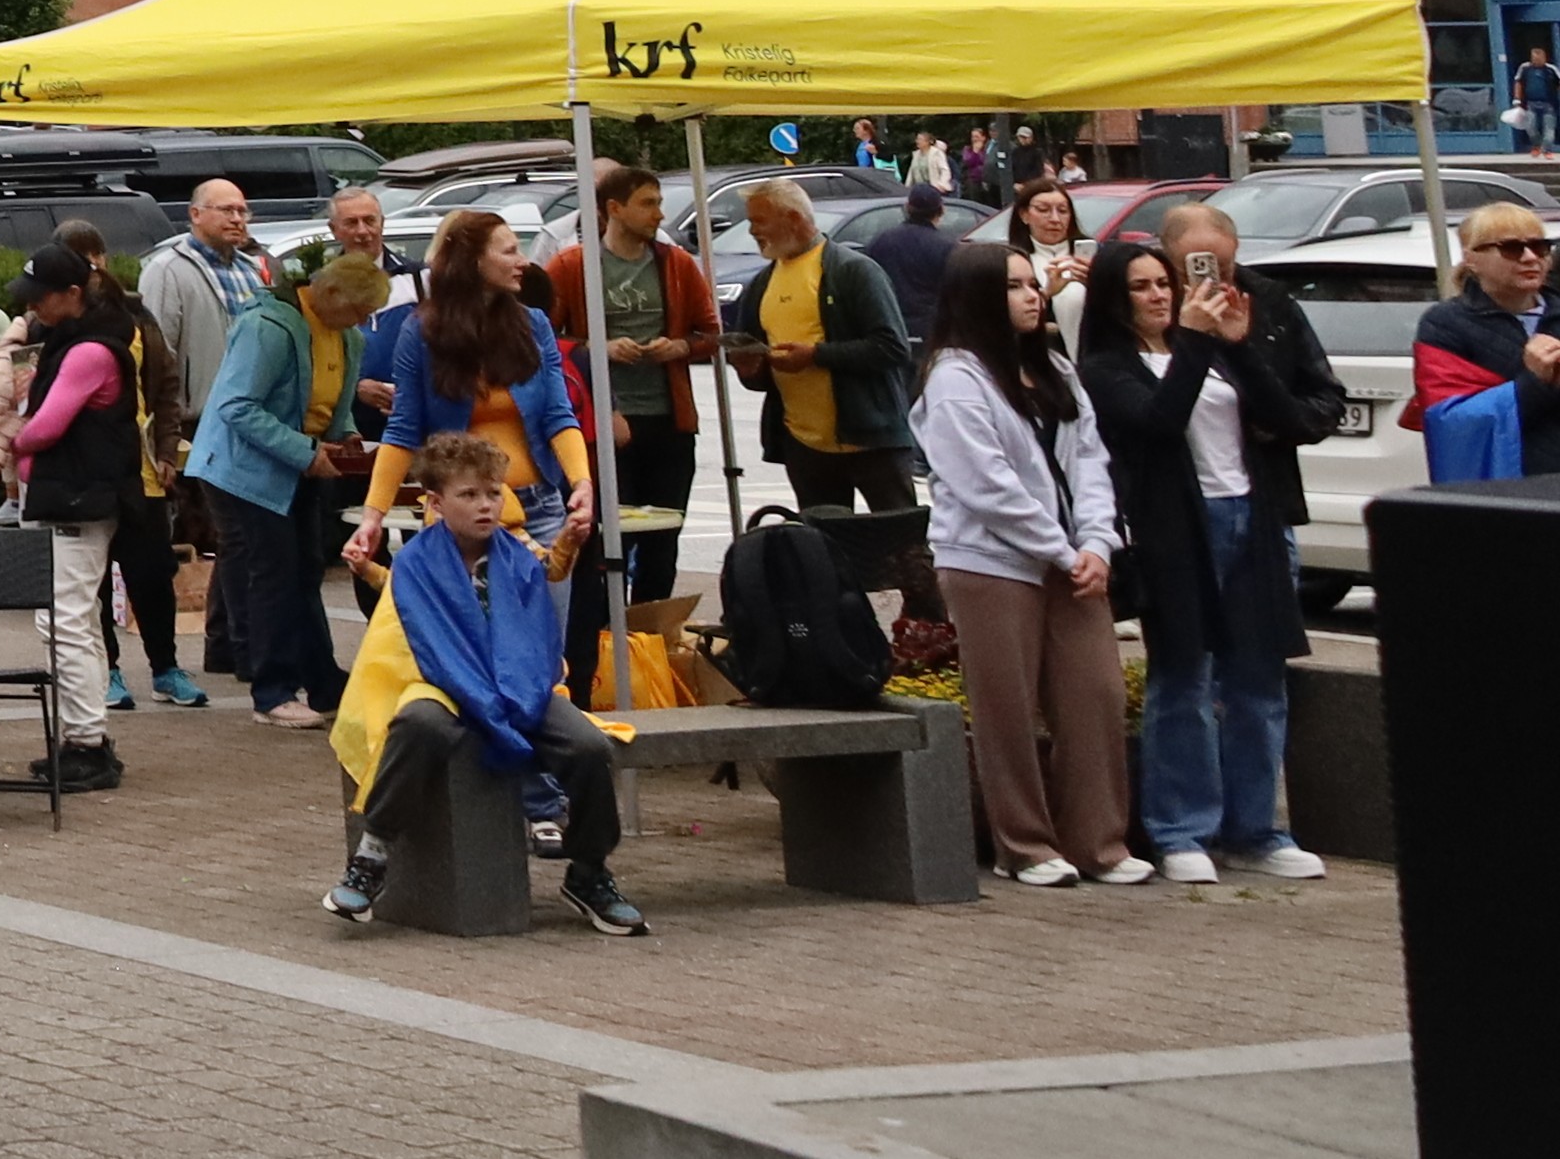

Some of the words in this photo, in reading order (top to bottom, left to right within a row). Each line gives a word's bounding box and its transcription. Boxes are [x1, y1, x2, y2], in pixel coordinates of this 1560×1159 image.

[602, 21, 703, 79] krf
[721, 43, 795, 65] Kristelig
[722, 65, 814, 87] Folkeparti
